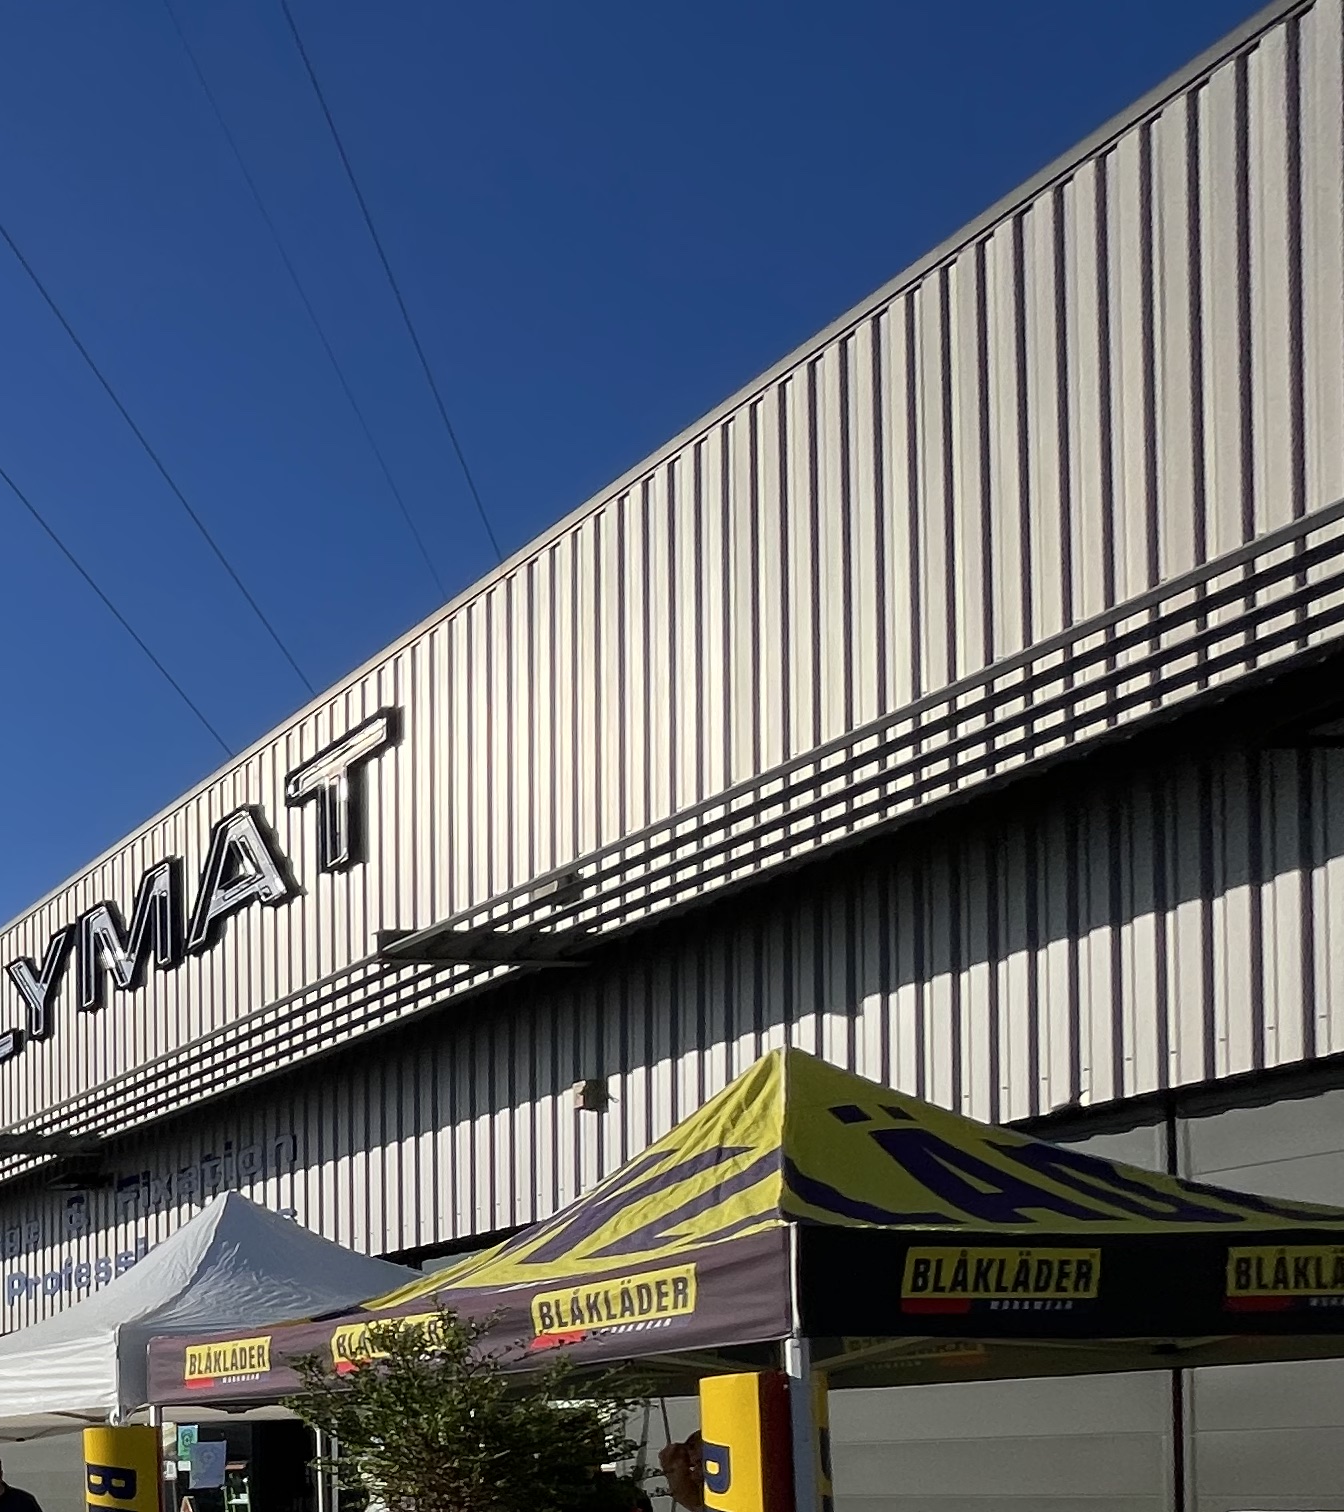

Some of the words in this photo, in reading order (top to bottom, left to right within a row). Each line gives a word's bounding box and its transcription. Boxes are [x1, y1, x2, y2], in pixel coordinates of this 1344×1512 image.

[116, 1133, 297, 1222] Fixation
[7, 1236, 160, 1306] Professi
[910, 1249, 1093, 1293] BLÅKLÄDER
[1235, 1247, 1344, 1290] BLÅKLÄ
[539, 1276, 689, 1330] BLÅKLÄDER
[189, 1343, 266, 1376] BLÅKLÄDER
